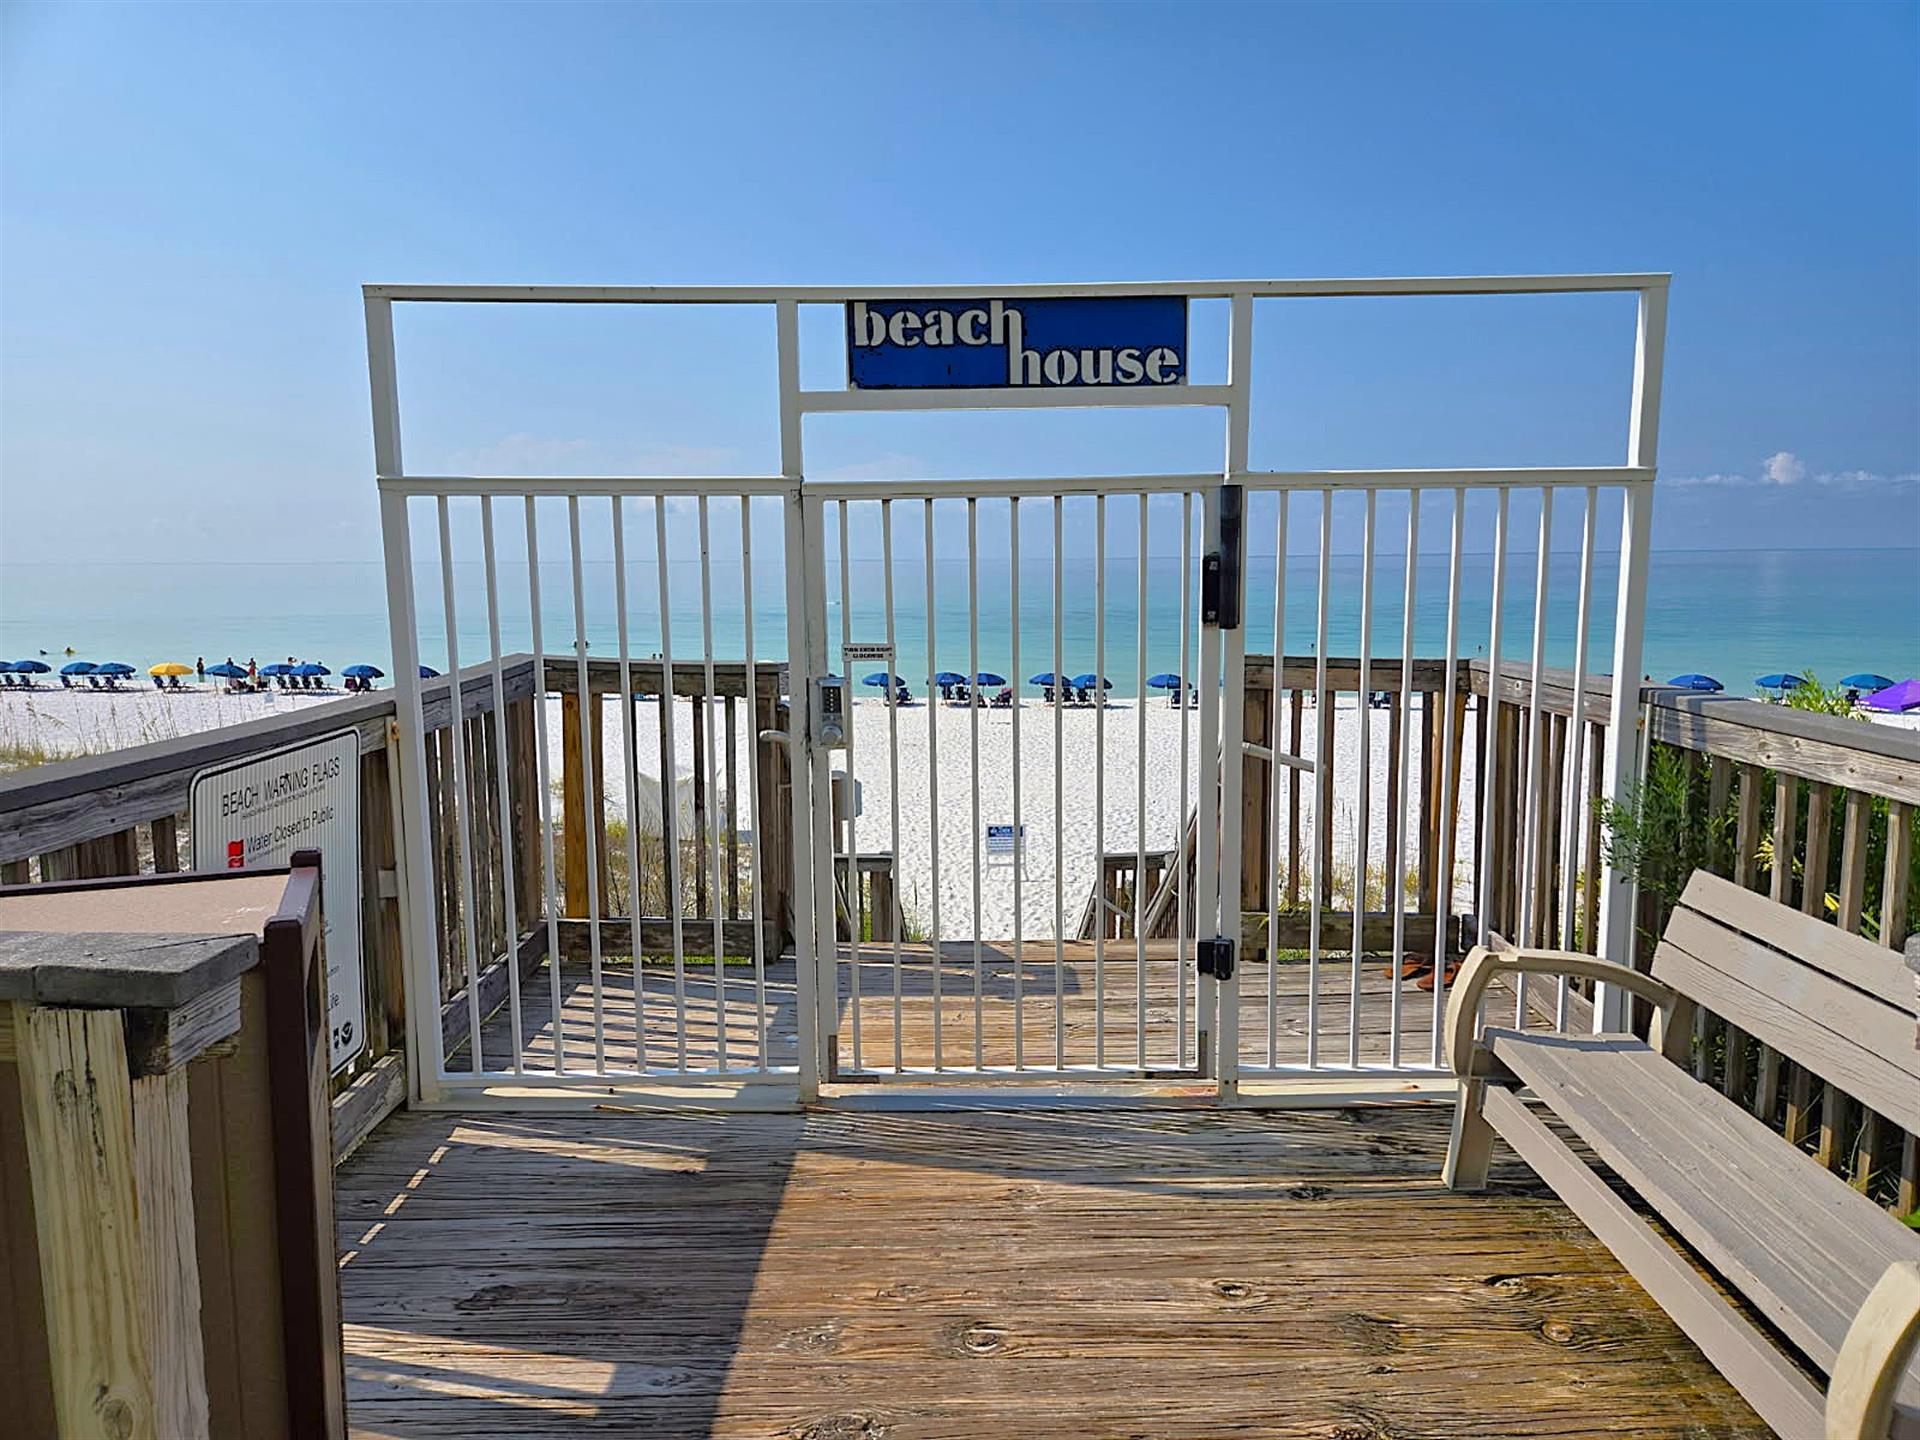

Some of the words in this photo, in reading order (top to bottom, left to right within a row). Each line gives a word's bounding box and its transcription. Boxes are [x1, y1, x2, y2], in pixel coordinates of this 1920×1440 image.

[853, 300, 1022, 347] beach
[1009, 326, 1180, 385] house
[222, 785, 258, 816] BEACH
[264, 767, 308, 800] WARNING
[312, 757, 340, 785] FLAGS
[248, 832, 272, 854] Water
[274, 821, 301, 843] Closed
[302, 817, 310, 830] to
[312, 806, 334, 828] Public
